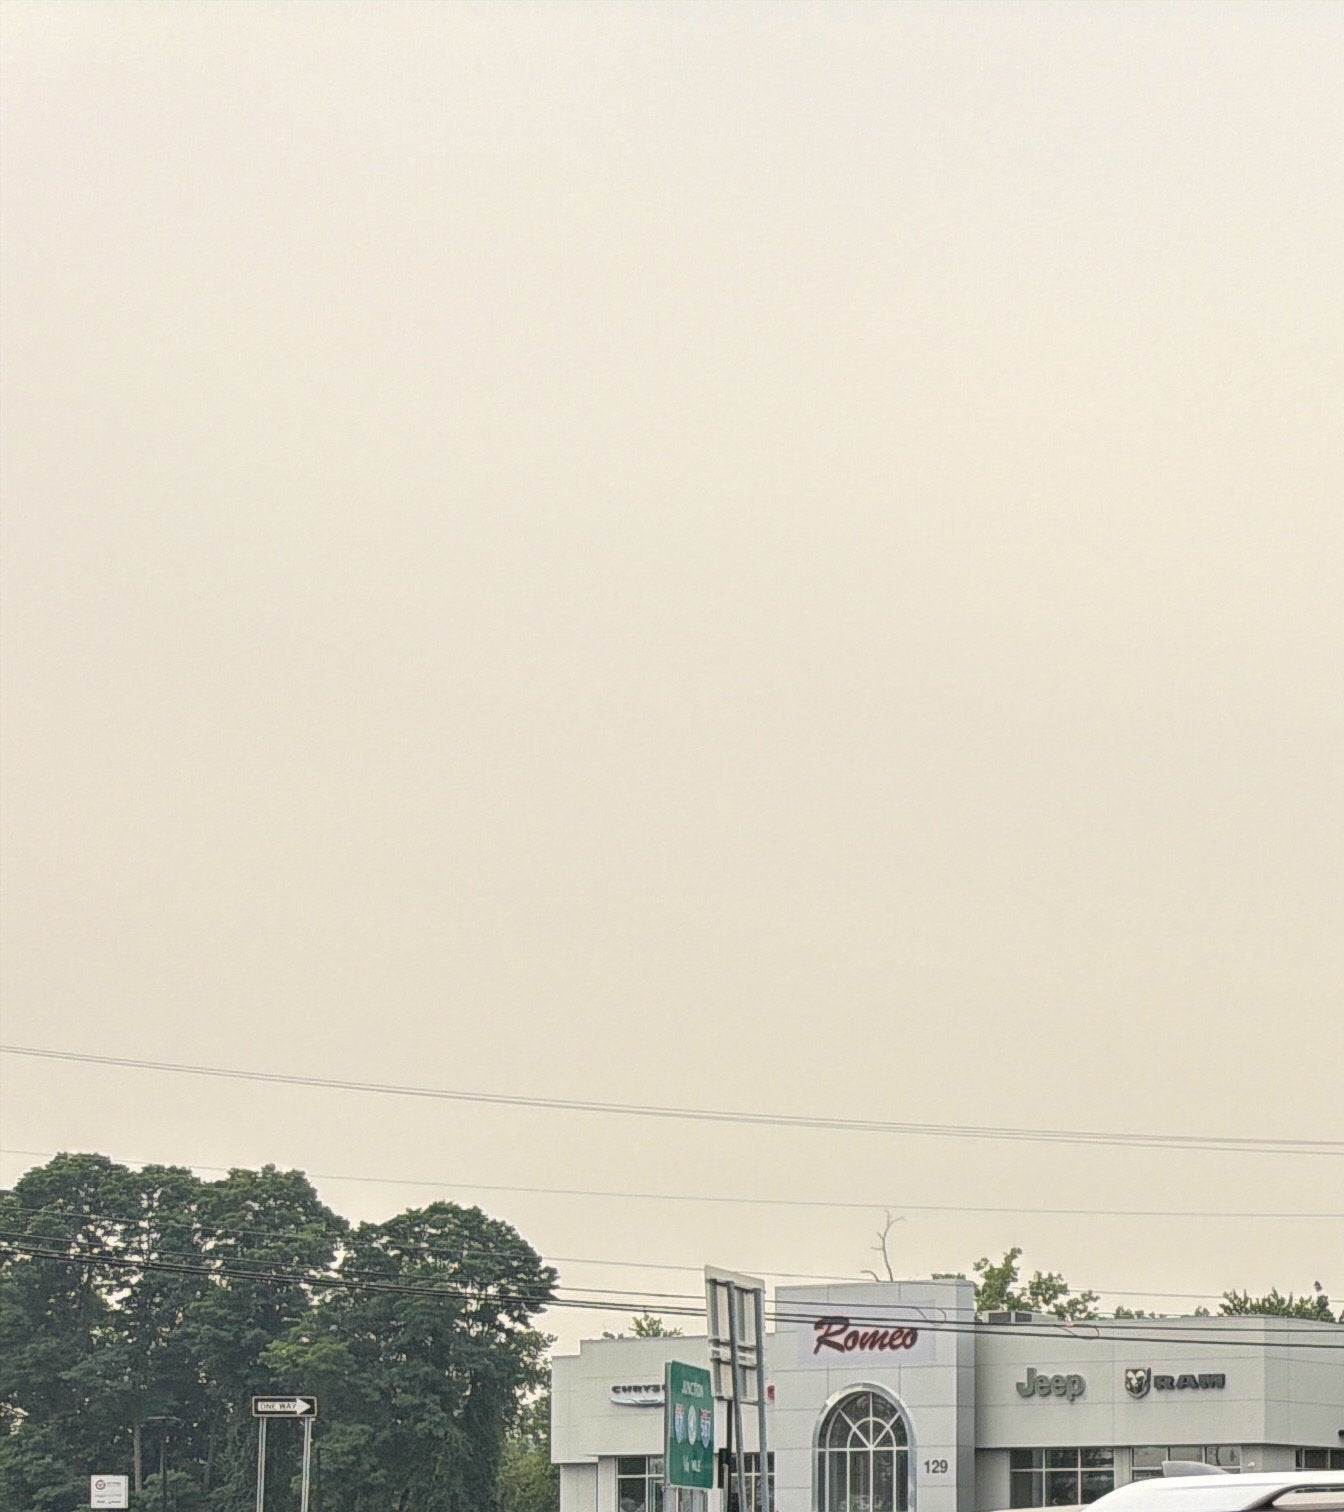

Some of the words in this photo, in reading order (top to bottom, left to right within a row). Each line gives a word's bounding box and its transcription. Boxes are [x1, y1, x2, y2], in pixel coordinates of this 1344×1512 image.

[813, 1316, 919, 1356] Romeo
[611, 1384, 666, 1394] CHRYS
[1016, 1367, 1087, 1405] Jeep
[1154, 1373, 1226, 1391] RAM
[279, 1402, 297, 1410] WAY
[923, 1459, 949, 1475] 129
